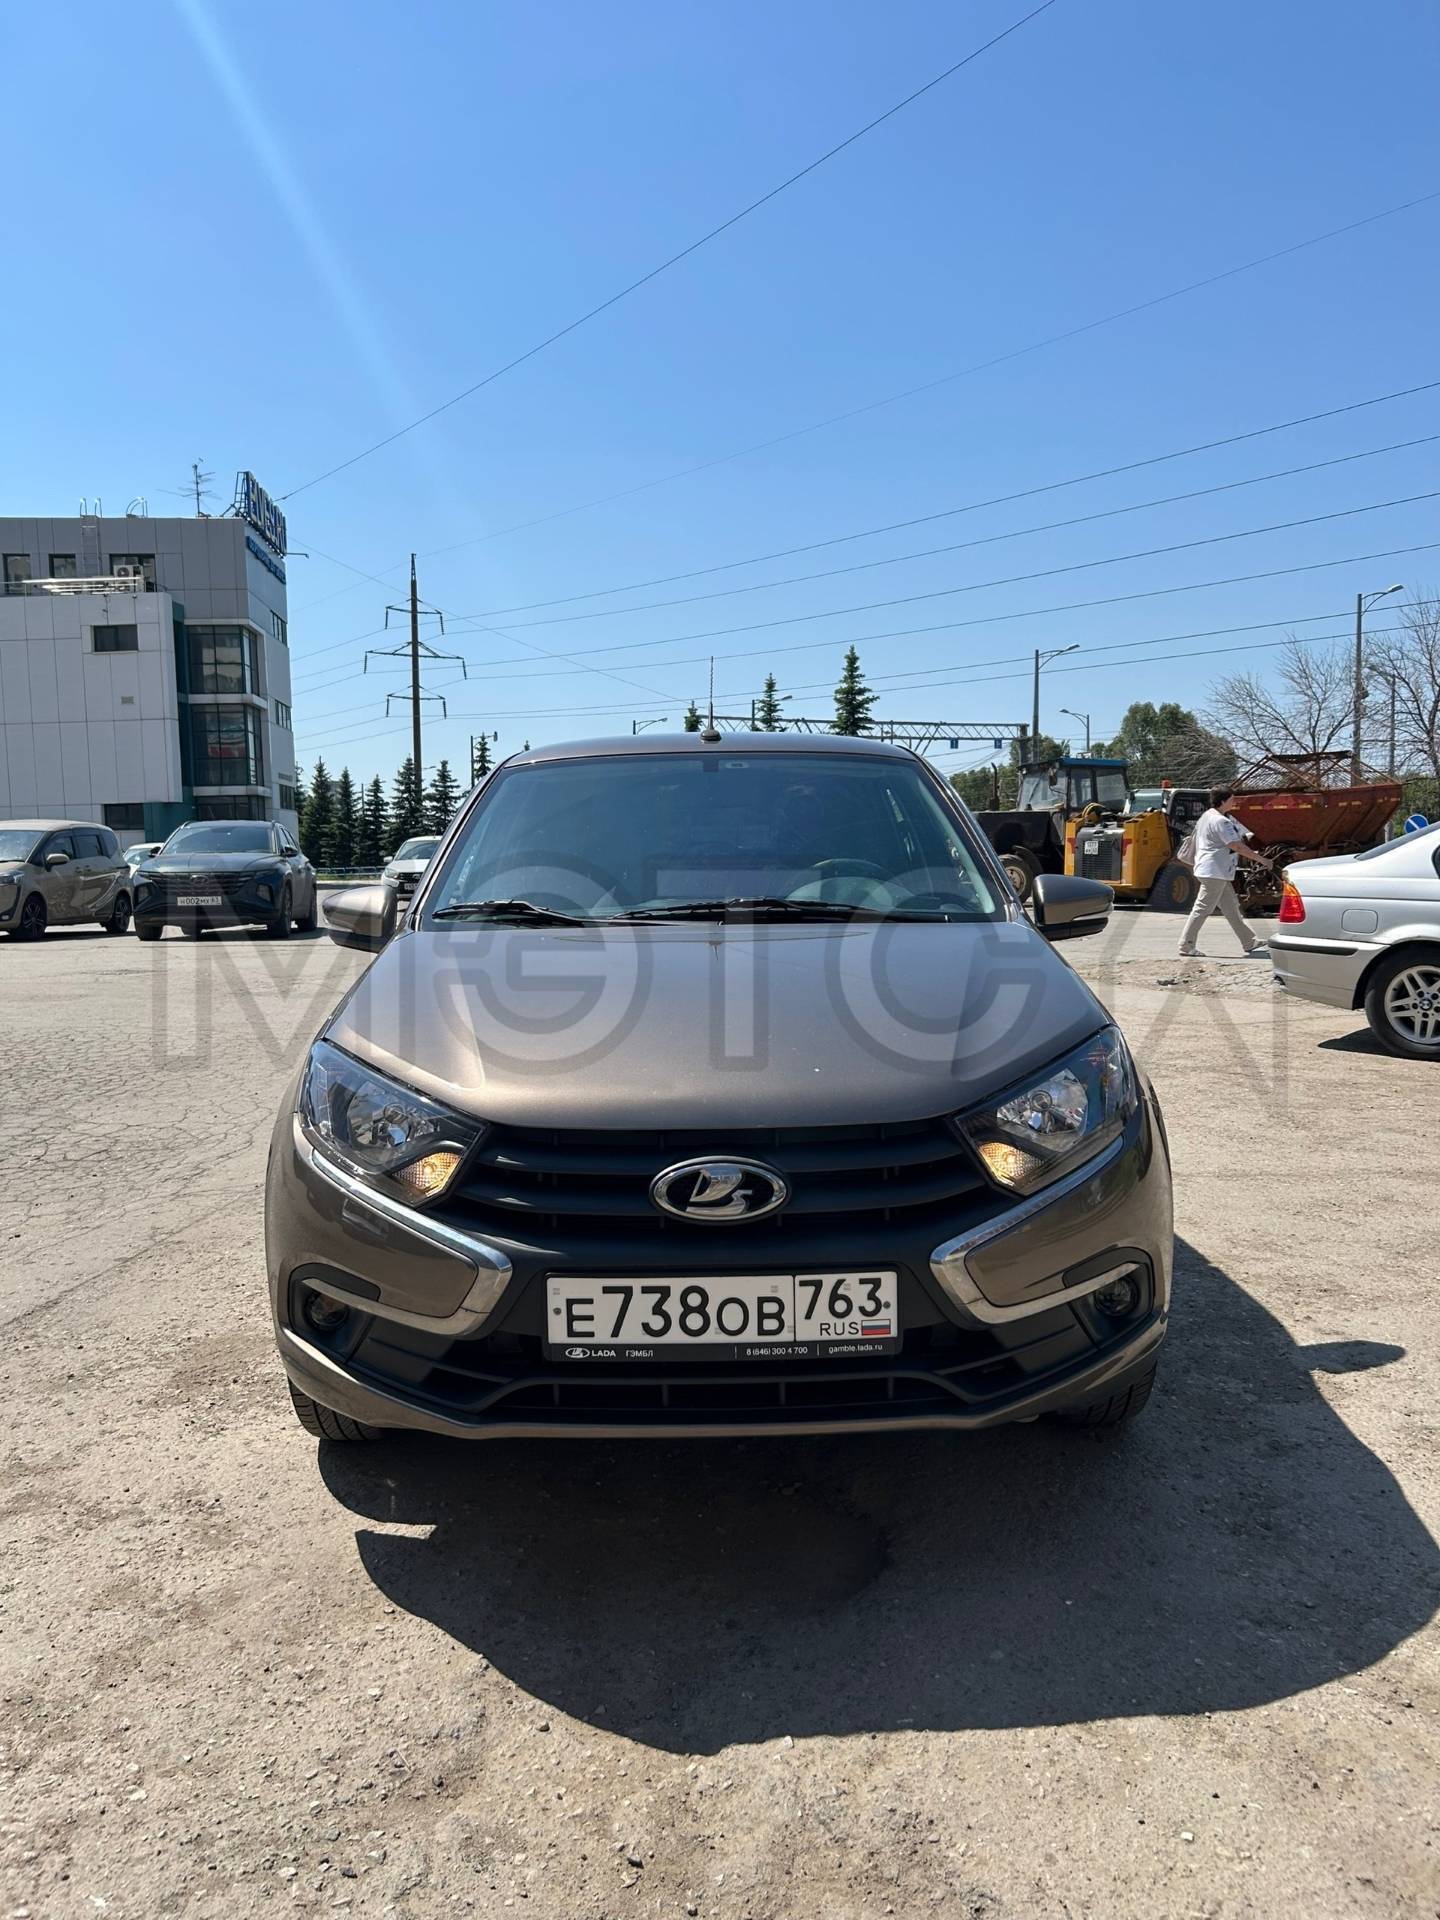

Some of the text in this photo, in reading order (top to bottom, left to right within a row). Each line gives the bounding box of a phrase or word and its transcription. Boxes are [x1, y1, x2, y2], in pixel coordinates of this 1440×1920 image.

[798, 1277, 883, 1321] 763
[819, 1321, 860, 1337] RUS
[591, 1349, 617, 1358] LADA
[771, 1347, 786, 1355] 300
[794, 1346, 809, 1354] 700
[828, 1343, 883, 1355] gamble.lada.ru
